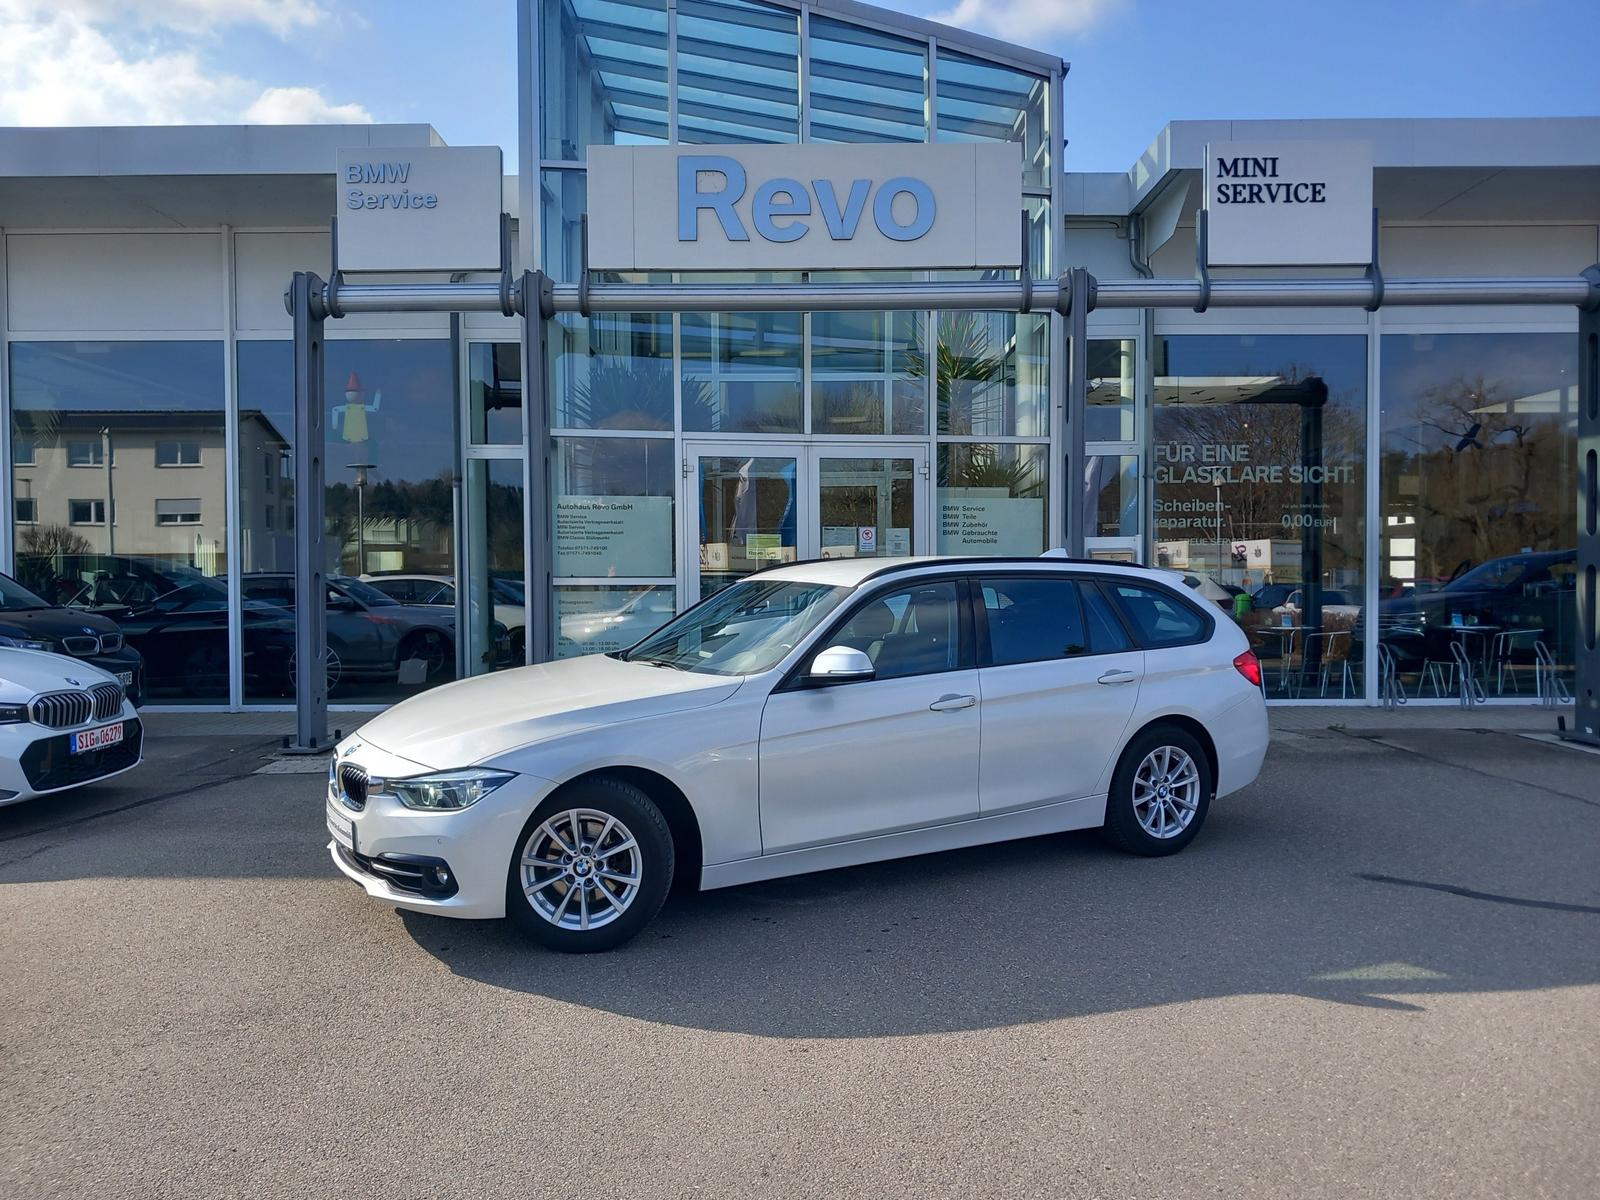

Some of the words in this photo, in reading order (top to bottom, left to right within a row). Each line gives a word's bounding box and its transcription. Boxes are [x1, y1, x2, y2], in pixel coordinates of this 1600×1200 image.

[345, 162, 411, 184] BMW
[1216, 157, 1279, 178] MINI
[346, 188, 438, 210] Service
[677, 155, 937, 243] Revo
[1216, 183, 1326, 204] SERVICE
[1153, 441, 1195, 462] FÜR
[1202, 444, 1249, 462] EINE
[1153, 465, 1283, 484] GLASKLARE
[1289, 465, 1355, 484] SICHT.
[1153, 498, 1232, 512] Scheiben-
[1281, 514, 1313, 529] 0,00
[78, 733, 95, 750] SIG
[100, 724, 122, 744] 06279
